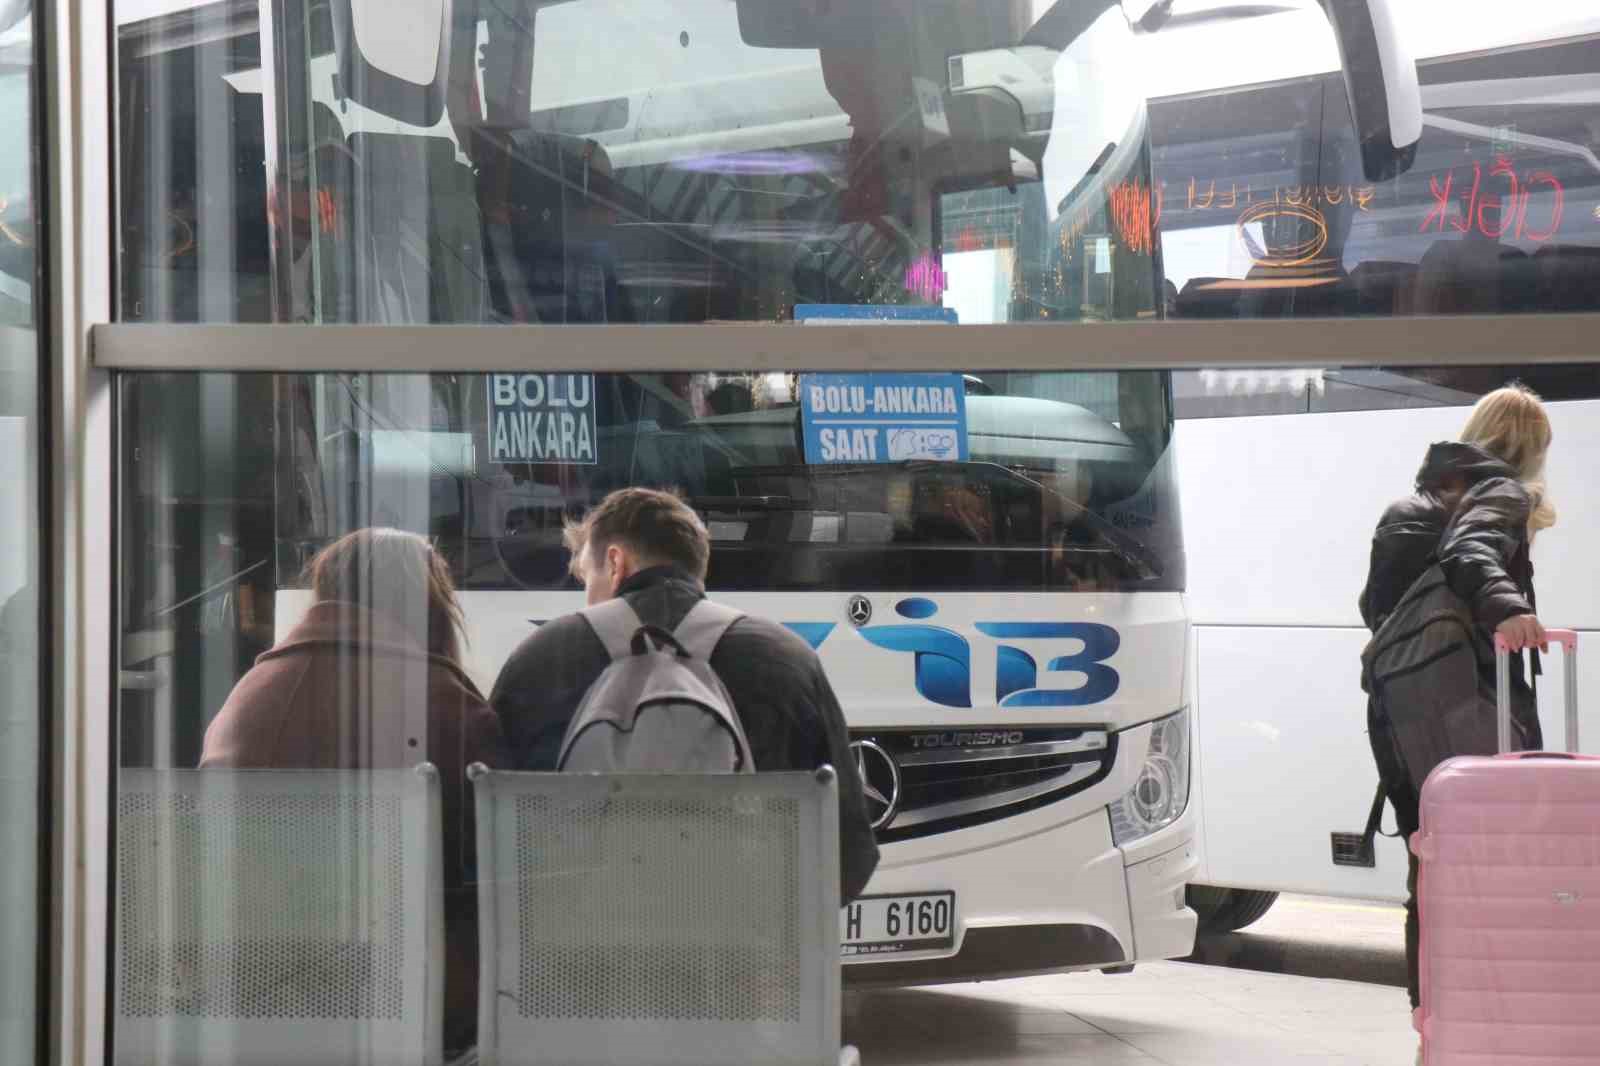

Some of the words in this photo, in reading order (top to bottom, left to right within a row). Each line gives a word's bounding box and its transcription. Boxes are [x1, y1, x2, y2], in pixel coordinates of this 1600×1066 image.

[493, 374, 590, 408] BOLU
[810, 385, 958, 414] BOLU-ANKARA
[494, 411, 593, 459] ANKARA
[820, 428, 880, 461] SAAT
[911, 730, 1024, 748] TOURISMO
[886, 899, 948, 936] 6160
